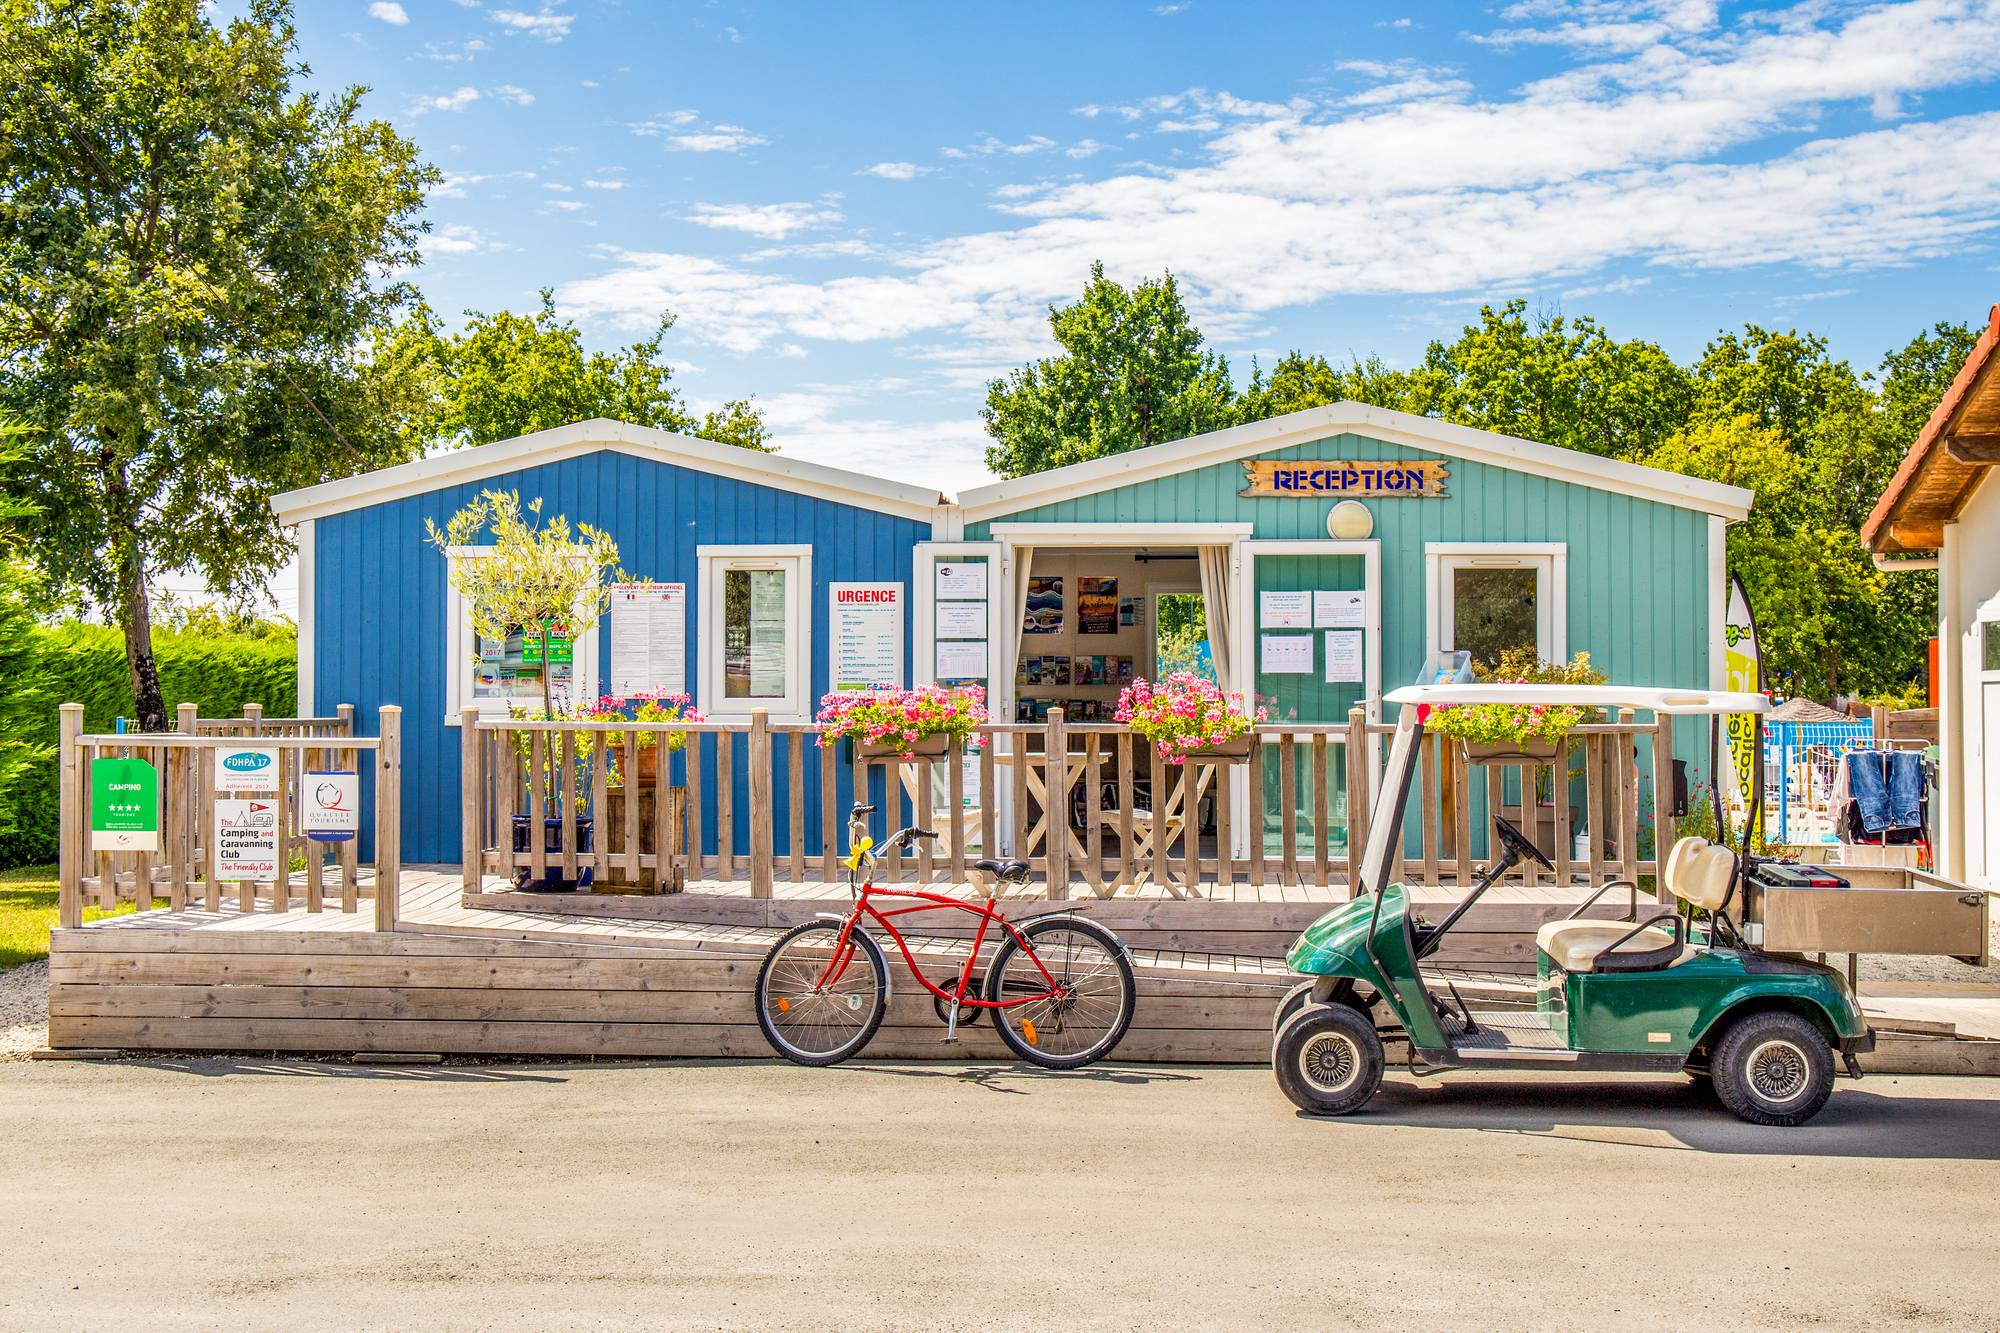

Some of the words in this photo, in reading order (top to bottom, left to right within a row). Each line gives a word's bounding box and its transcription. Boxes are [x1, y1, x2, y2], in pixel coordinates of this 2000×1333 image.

[1274, 470, 1424, 490] RECEPTION
[837, 590, 897, 602] URGENCE
[258, 758, 268, 767] 17
[108, 783, 142, 791] CAMPING
[221, 829, 259, 839] Camping
[221, 840, 273, 849] Caravanning
[221, 850, 240, 858] Club
[221, 863, 233, 871] The
[233, 863, 258, 874] Friendly
[259, 863, 273, 871] Club
